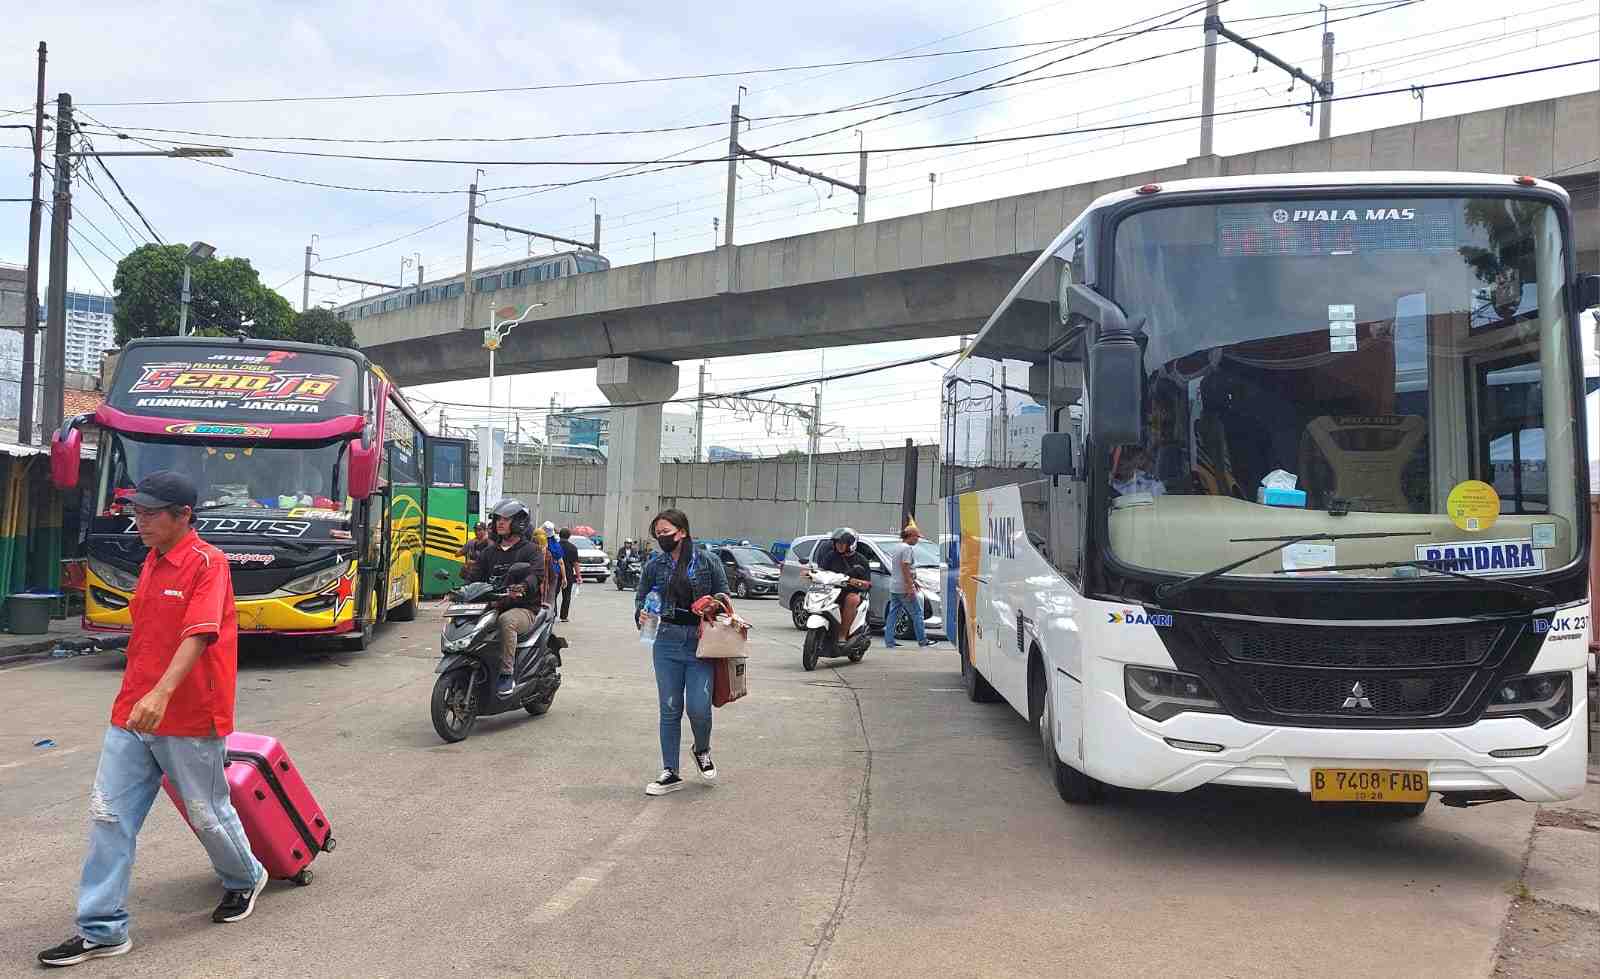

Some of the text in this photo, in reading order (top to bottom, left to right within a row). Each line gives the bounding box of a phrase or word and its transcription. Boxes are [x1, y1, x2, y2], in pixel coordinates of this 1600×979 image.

[1293, 208, 1415, 222] PIALA MAS
[136, 398, 226, 409] KUNINGAN
[239, 401, 320, 413] JAKARTA
[1125, 614, 1172, 625] DAMRI
[1315, 771, 1424, 792] B 7408 FAB
